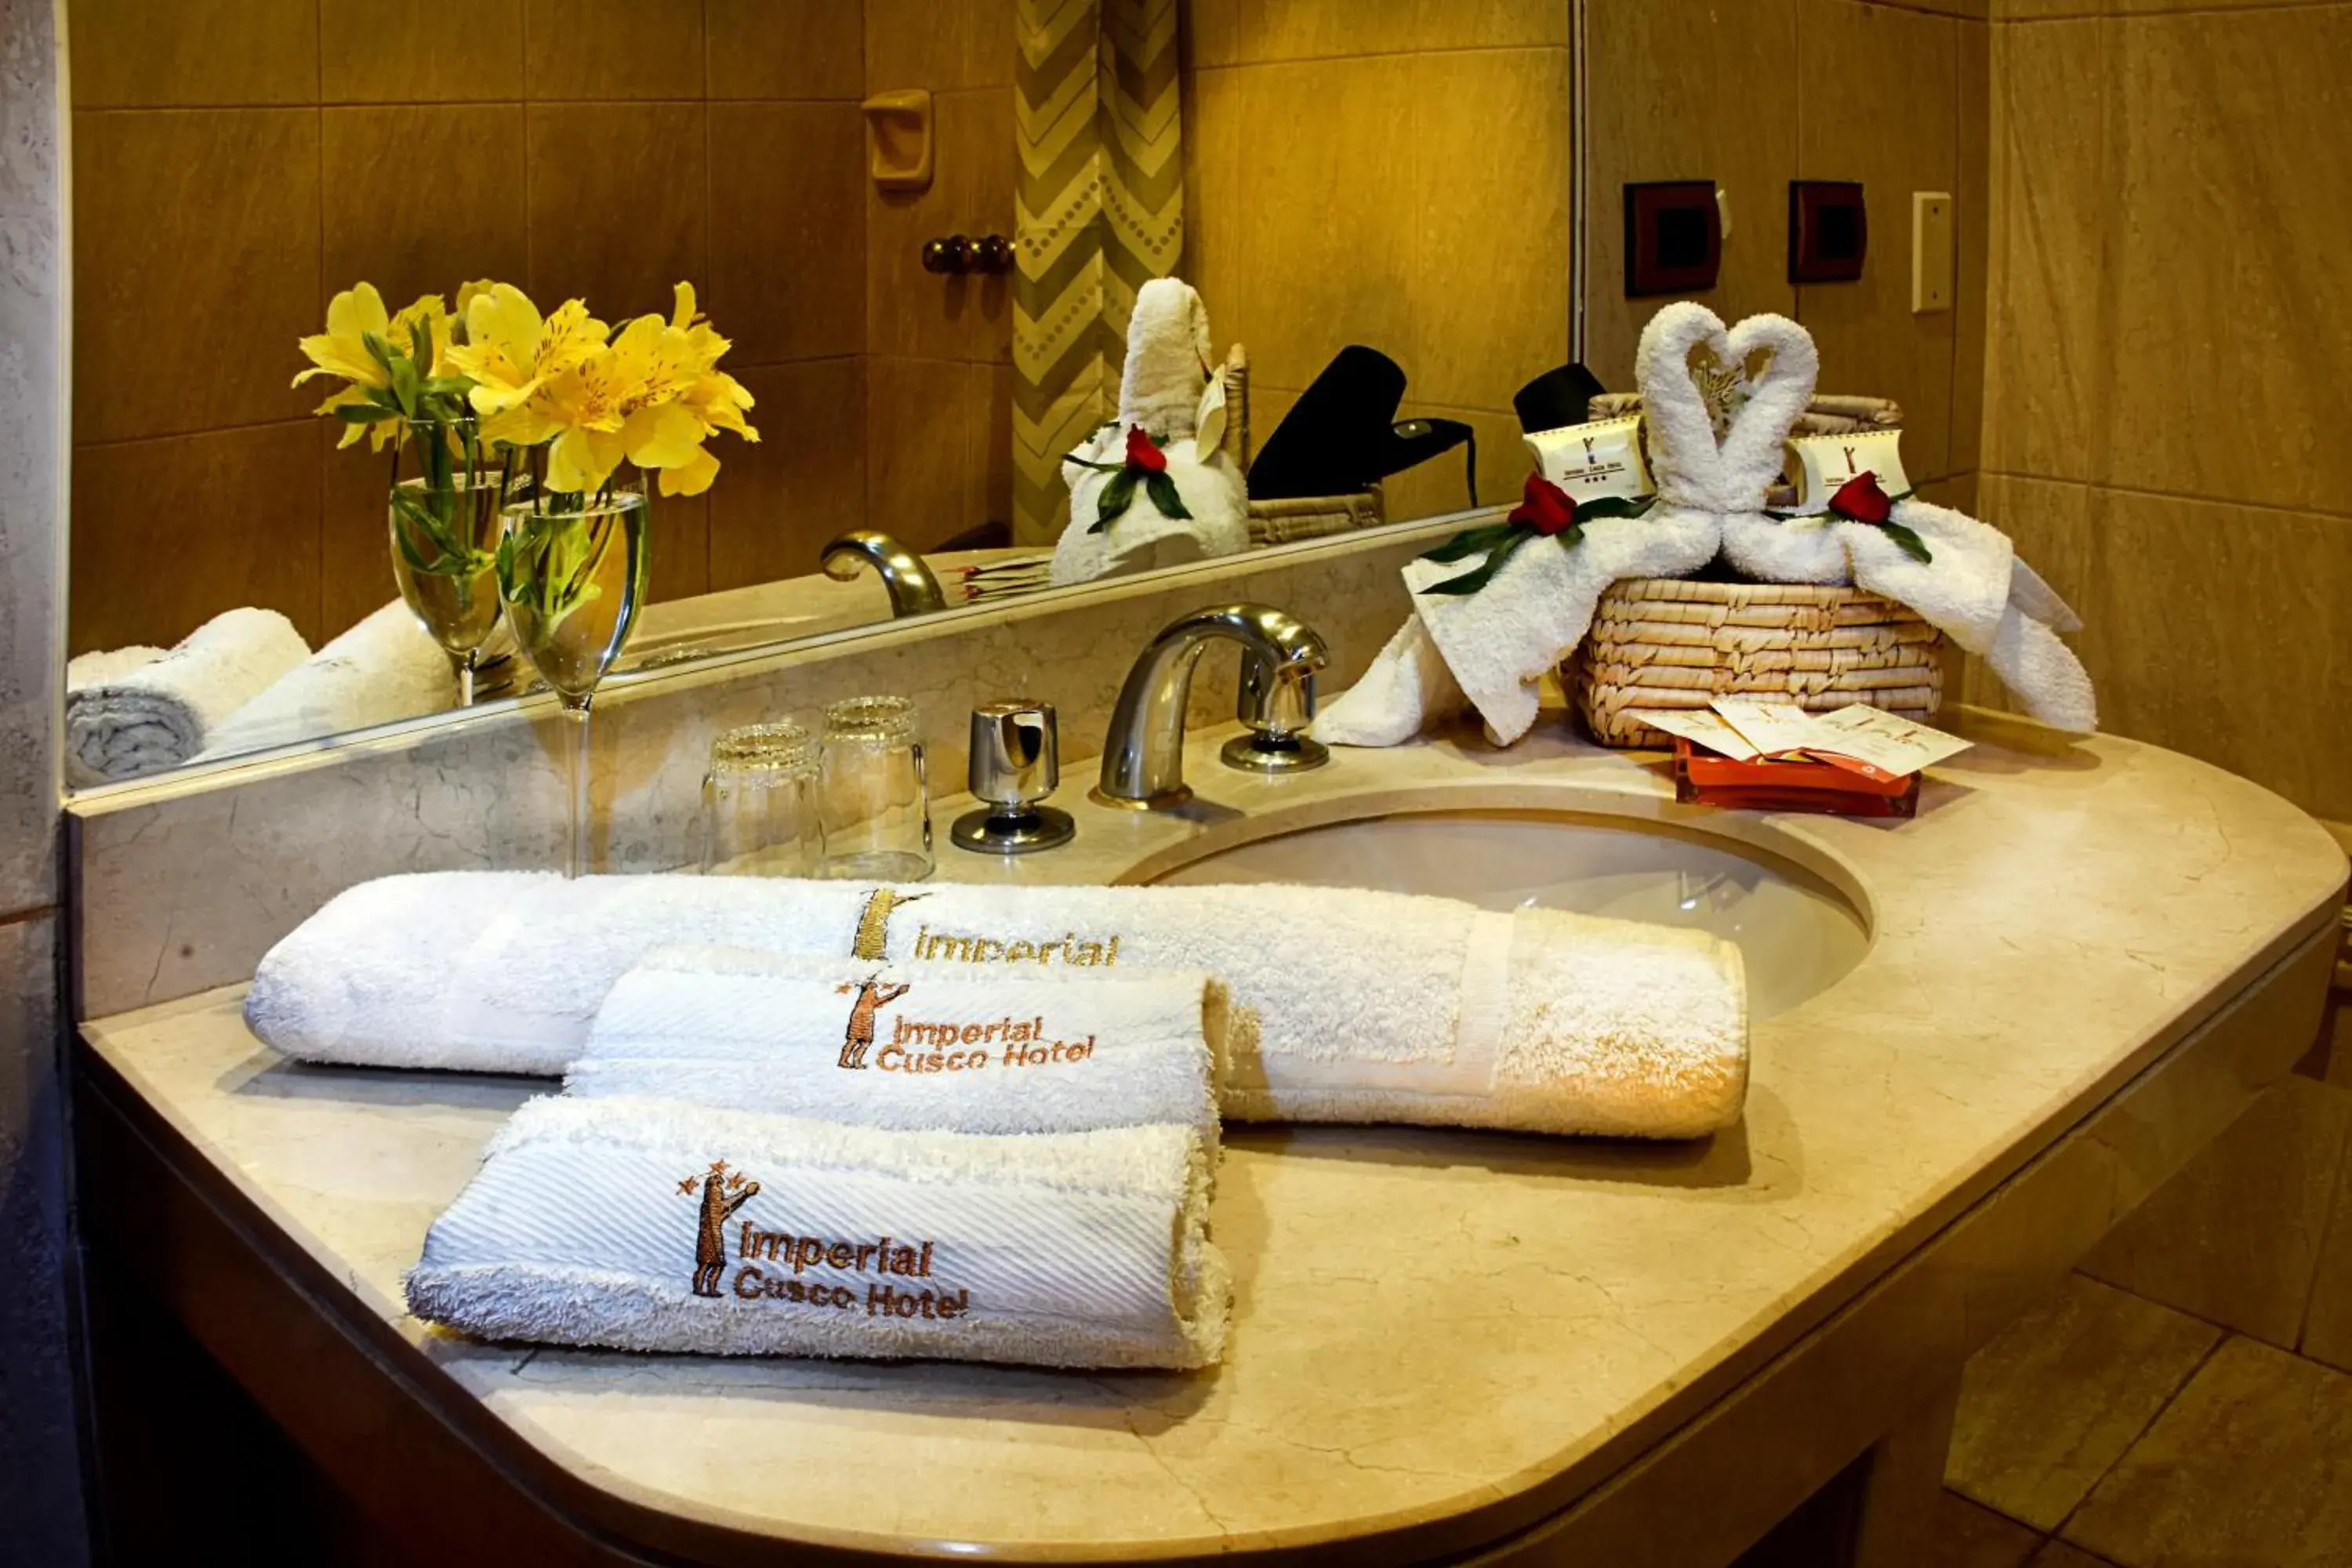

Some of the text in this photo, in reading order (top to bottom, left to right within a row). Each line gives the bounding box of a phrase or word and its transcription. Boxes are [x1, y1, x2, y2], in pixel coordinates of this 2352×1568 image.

[876, 1035, 1096, 1073] Cusco Hotel
[893, 1015, 1044, 1051] Imperial
[739, 1220, 934, 1276] Imperial
[733, 1266, 970, 1319] Cusco Hotel
